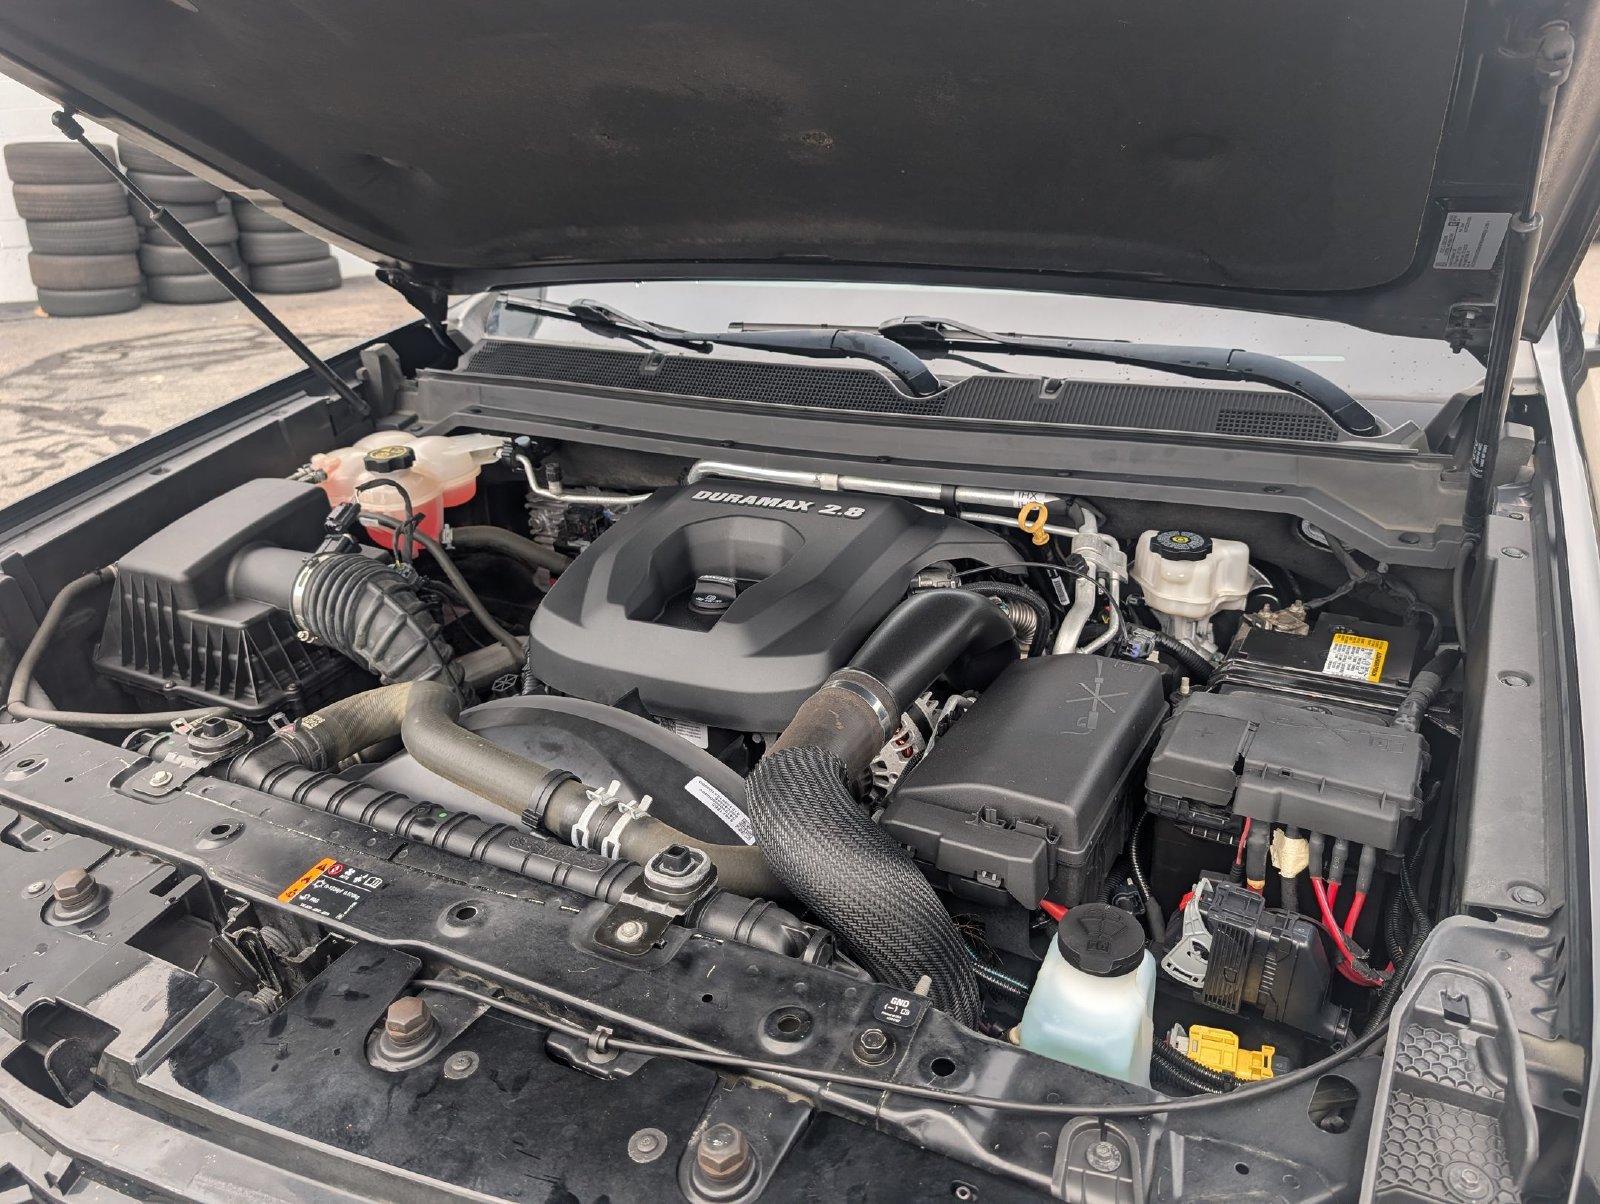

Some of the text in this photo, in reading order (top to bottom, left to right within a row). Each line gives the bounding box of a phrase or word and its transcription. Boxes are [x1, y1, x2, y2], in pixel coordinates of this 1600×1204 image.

[692, 490, 866, 519] DURAMAX 2.8
[890, 996, 910, 1008] GND
